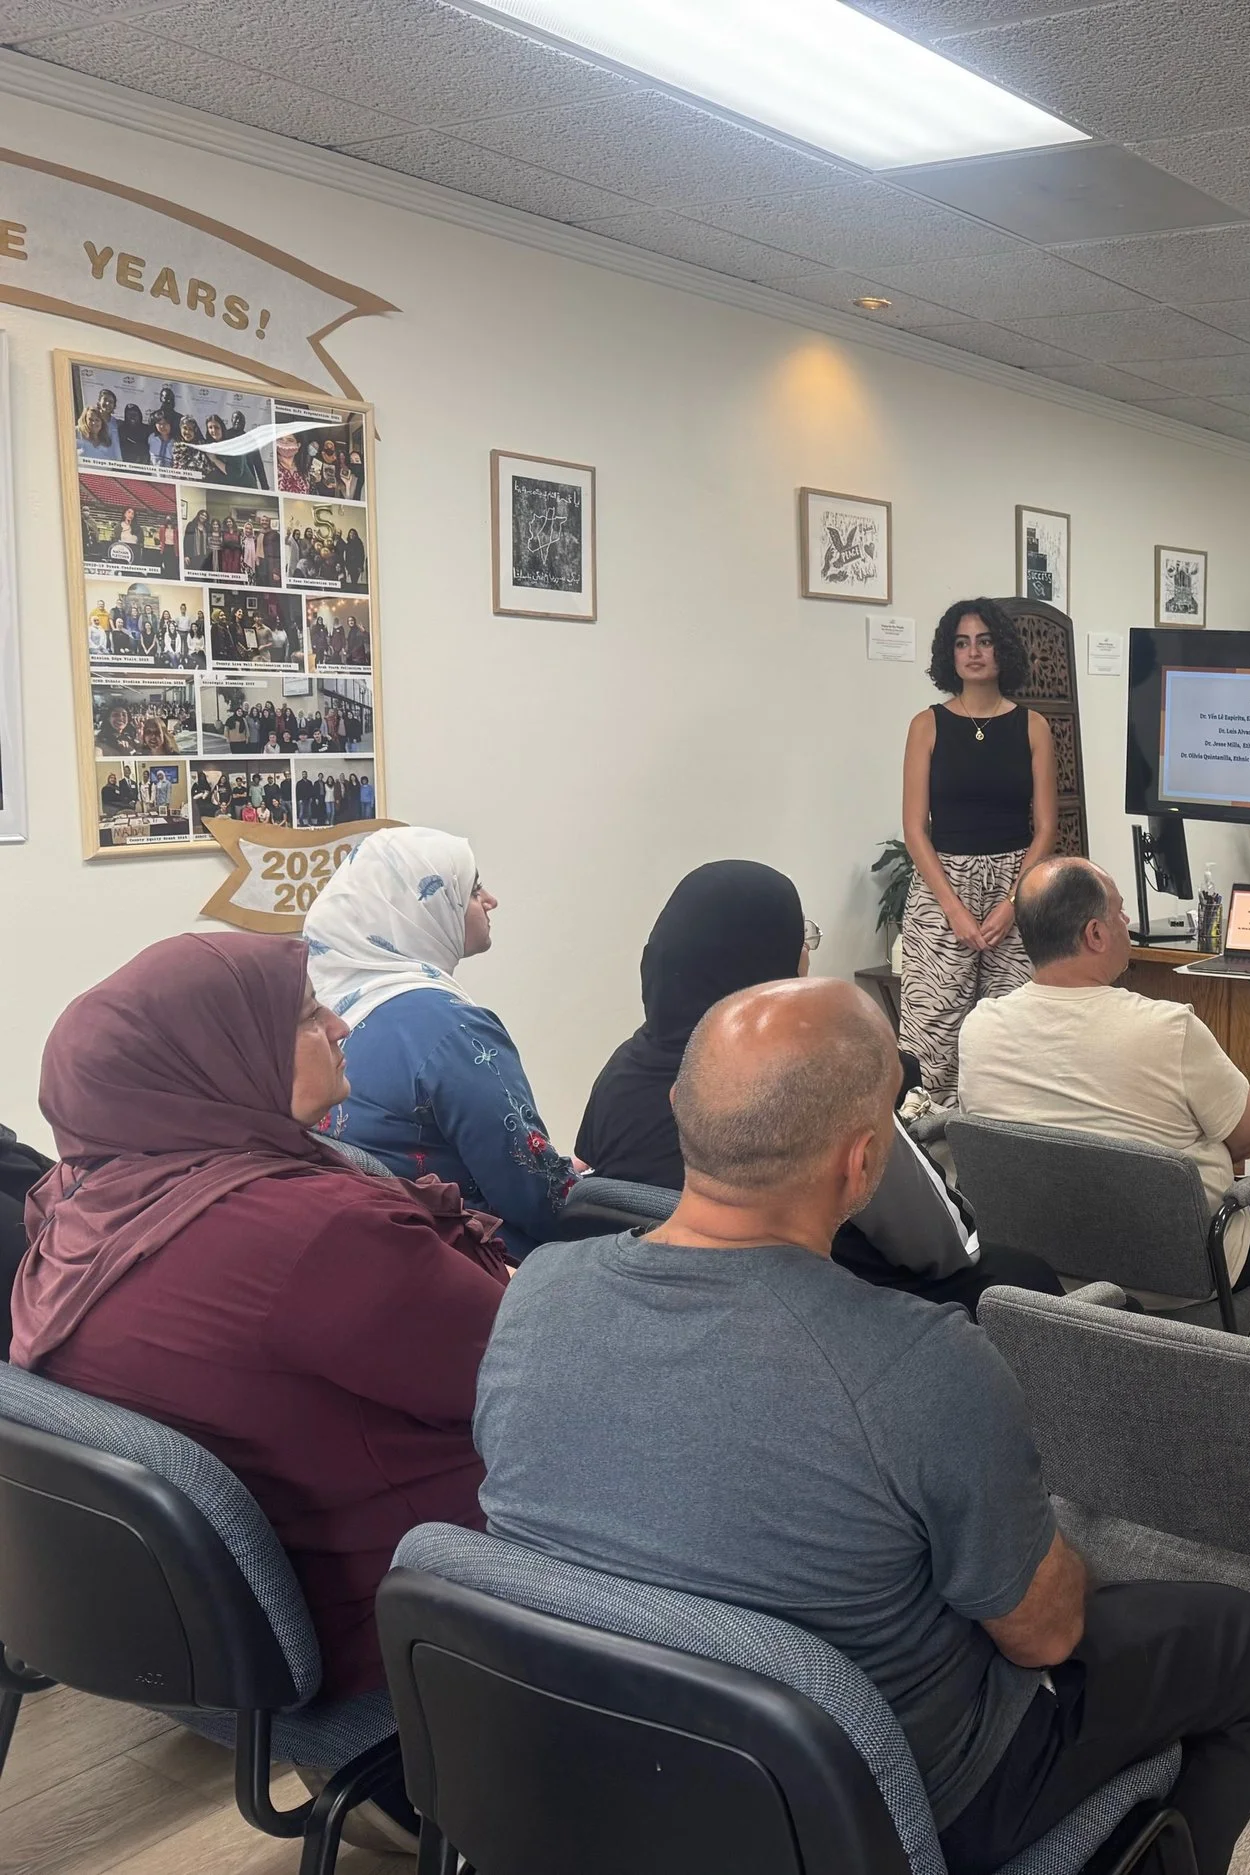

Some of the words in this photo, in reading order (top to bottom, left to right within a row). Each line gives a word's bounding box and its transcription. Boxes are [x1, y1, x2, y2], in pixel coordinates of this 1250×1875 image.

[83, 240, 272, 341] YEARS!
[841, 547, 860, 562] PEACE
[273, 876, 332, 913] 20
